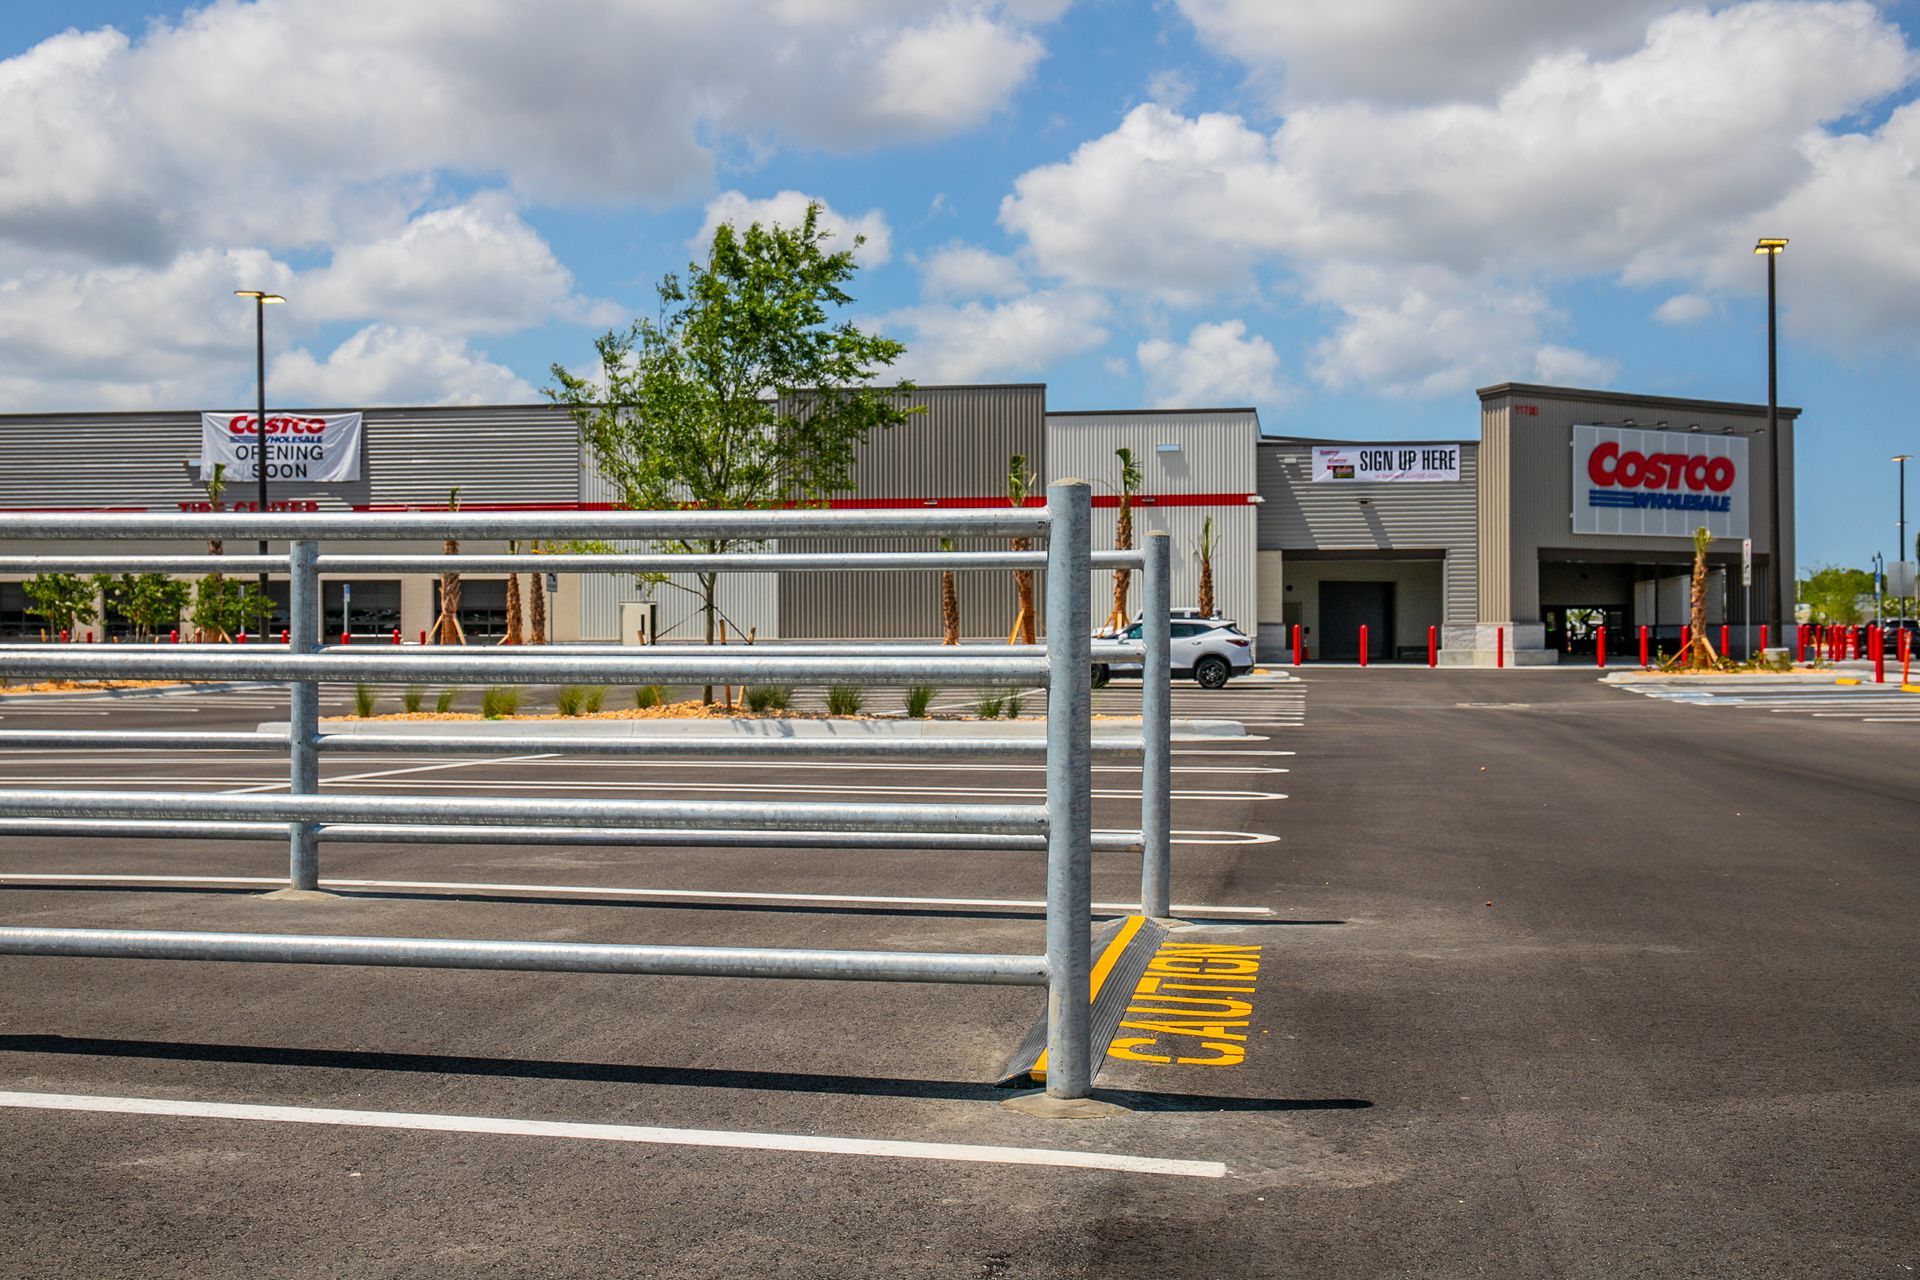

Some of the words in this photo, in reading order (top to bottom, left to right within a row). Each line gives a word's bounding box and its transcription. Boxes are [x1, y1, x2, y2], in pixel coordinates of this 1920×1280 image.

[229, 415, 326, 435] COSTCO
[235, 445, 324, 461] OPENING
[1360, 450, 1393, 472] SIGN
[1398, 450, 1417, 471] UP
[1422, 449, 1456, 471] HERE
[252, 463, 308, 479] SOON
[1588, 441, 1736, 493] COSTCO
[1633, 491, 1731, 512] WHOLESALE
[1106, 941, 1263, 1066] CAUTION
